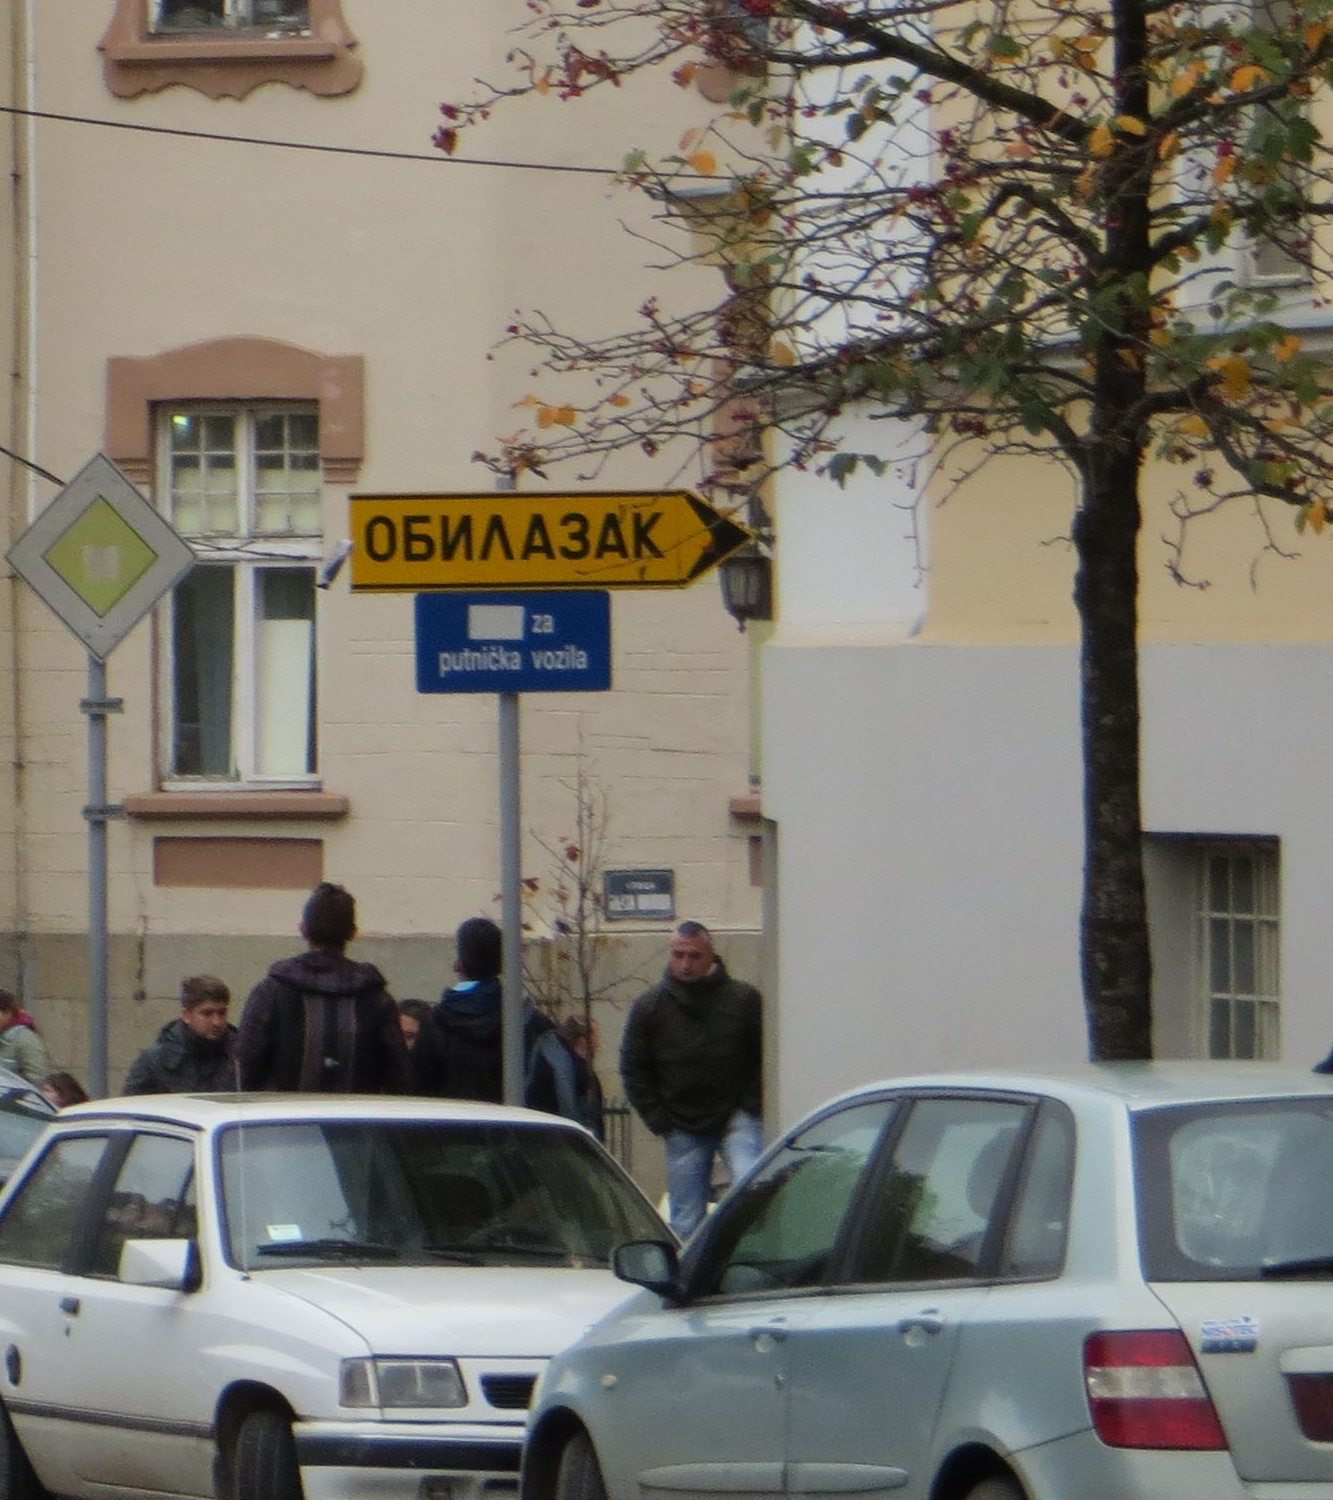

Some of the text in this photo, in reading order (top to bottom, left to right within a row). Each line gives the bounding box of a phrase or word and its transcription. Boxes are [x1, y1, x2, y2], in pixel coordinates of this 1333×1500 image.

[364, 512, 665, 563] ОБИЛАЗАК
[531, 614, 555, 634] za
[438, 645, 588, 677] putnička vozila
